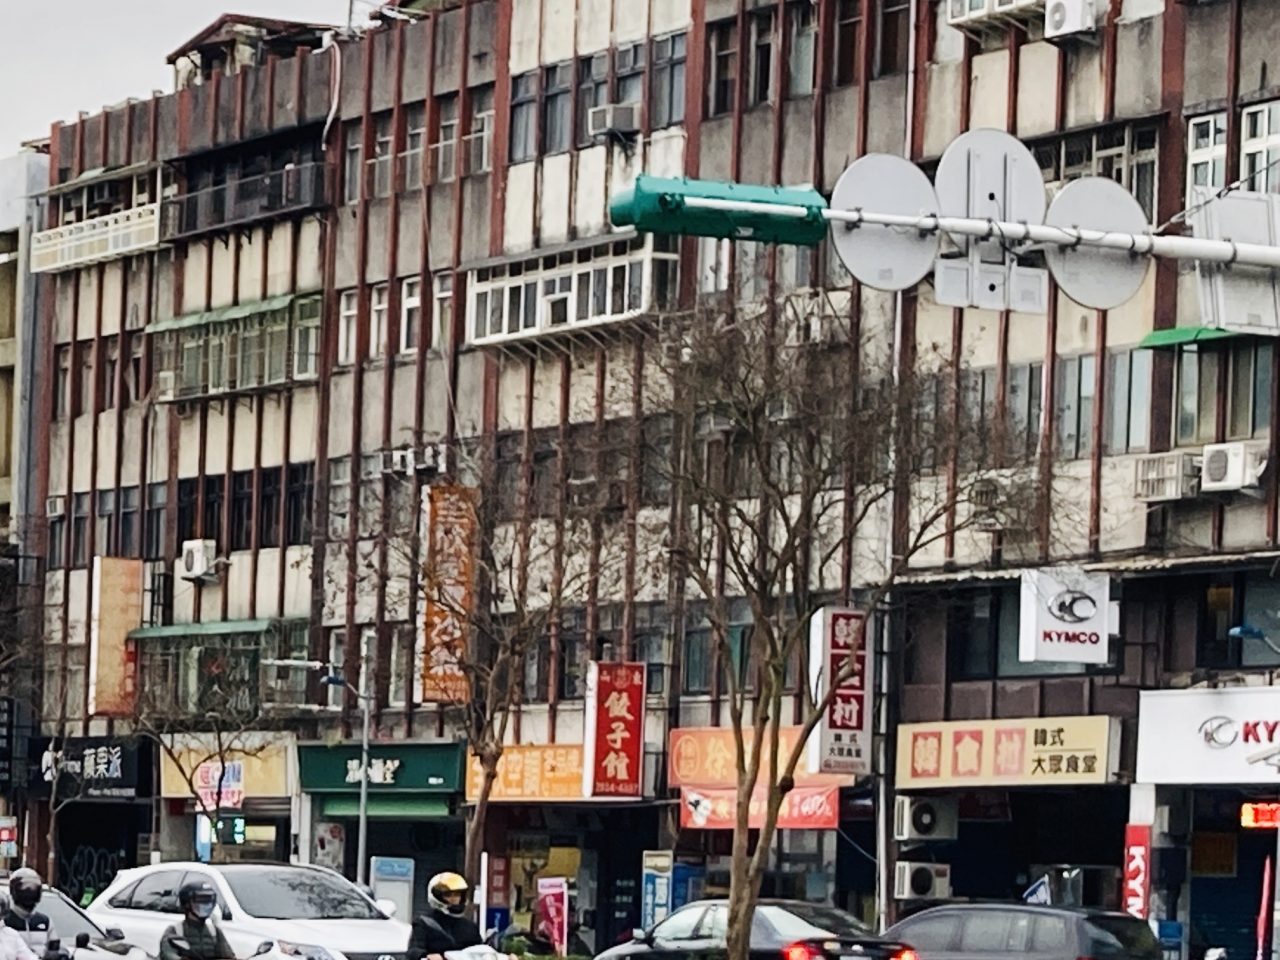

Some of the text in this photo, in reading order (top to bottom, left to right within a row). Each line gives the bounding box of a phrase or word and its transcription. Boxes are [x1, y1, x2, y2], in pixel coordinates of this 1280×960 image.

[1042, 630, 1100, 645] KYMCO
[601, 691, 635, 780] 餃子館
[1033, 727, 1065, 747] 韓式
[1031, 754, 1098, 776] 大眾食堂
